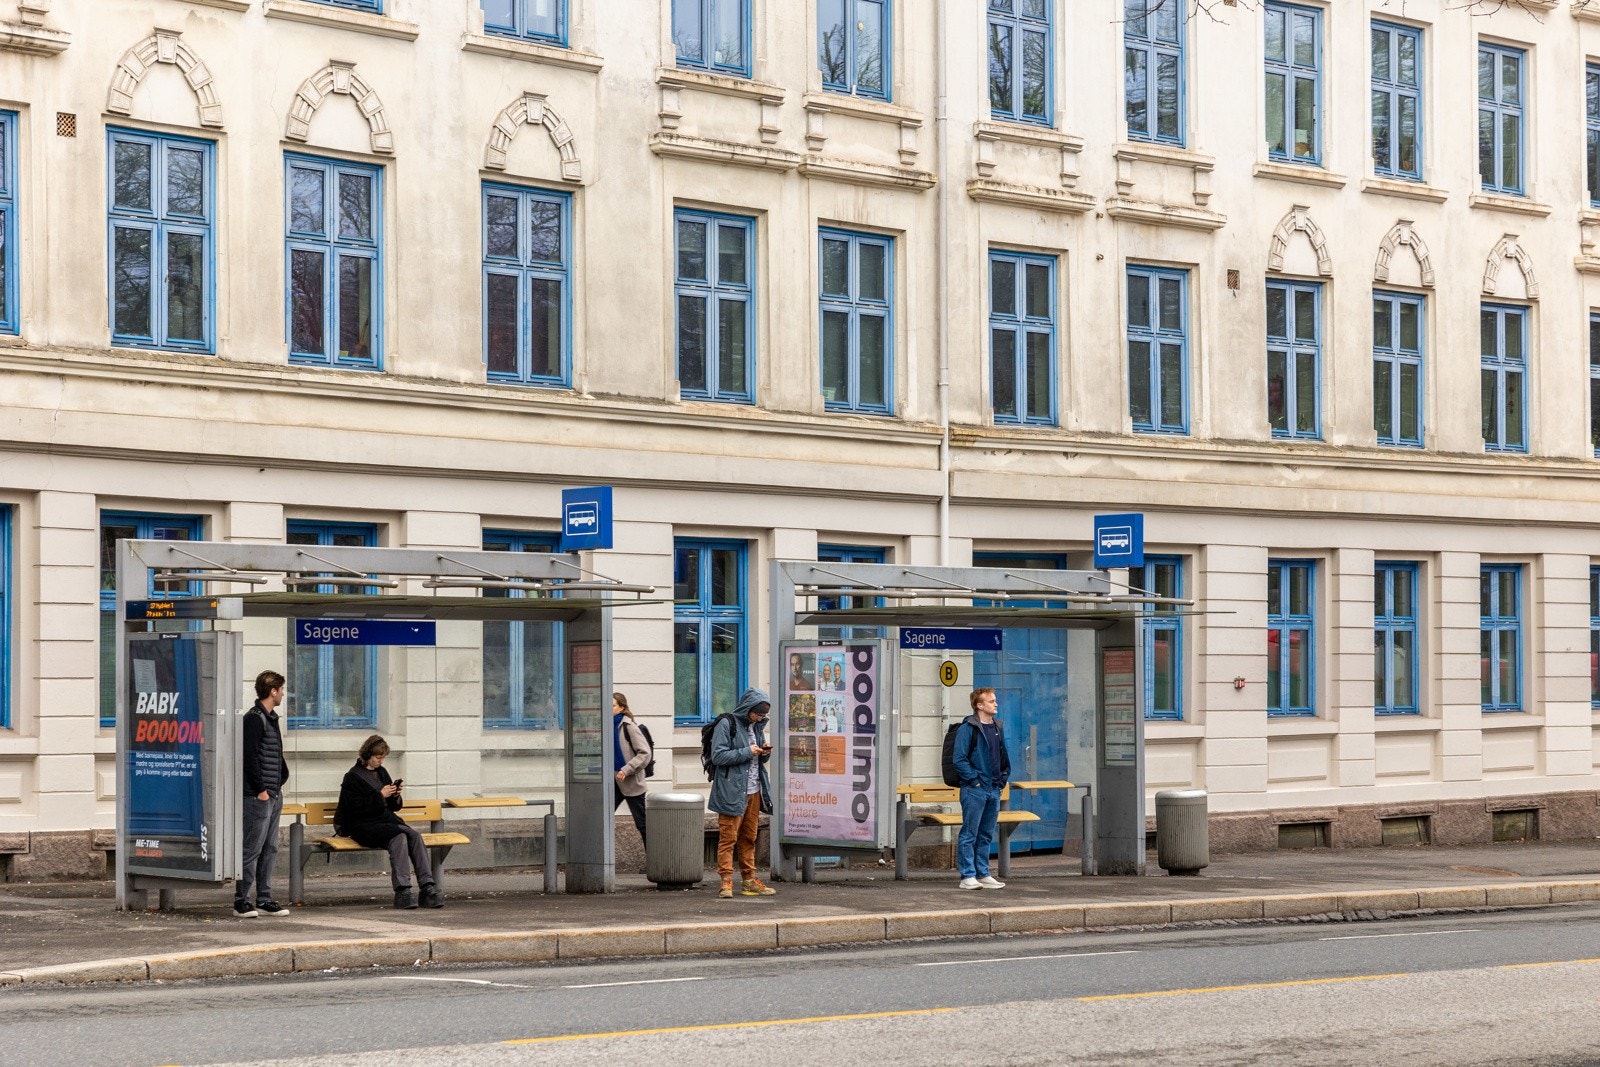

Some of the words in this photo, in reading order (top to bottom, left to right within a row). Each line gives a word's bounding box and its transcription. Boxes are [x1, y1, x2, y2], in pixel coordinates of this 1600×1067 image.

[303, 622, 360, 643] Sagene
[905, 630, 946, 647] Sagene
[945, 666, 953, 680] B
[136, 692, 180, 714] BABY.
[135, 719, 205, 744] BOOOOM.
[846, 645, 876, 824] podimo
[789, 778, 805, 790] For
[788, 792, 838, 805] tankefulle
[788, 807, 818, 820] lyttere
[135, 839, 160, 848] ME-TIME
[135, 848, 164, 858] INCLUDED
